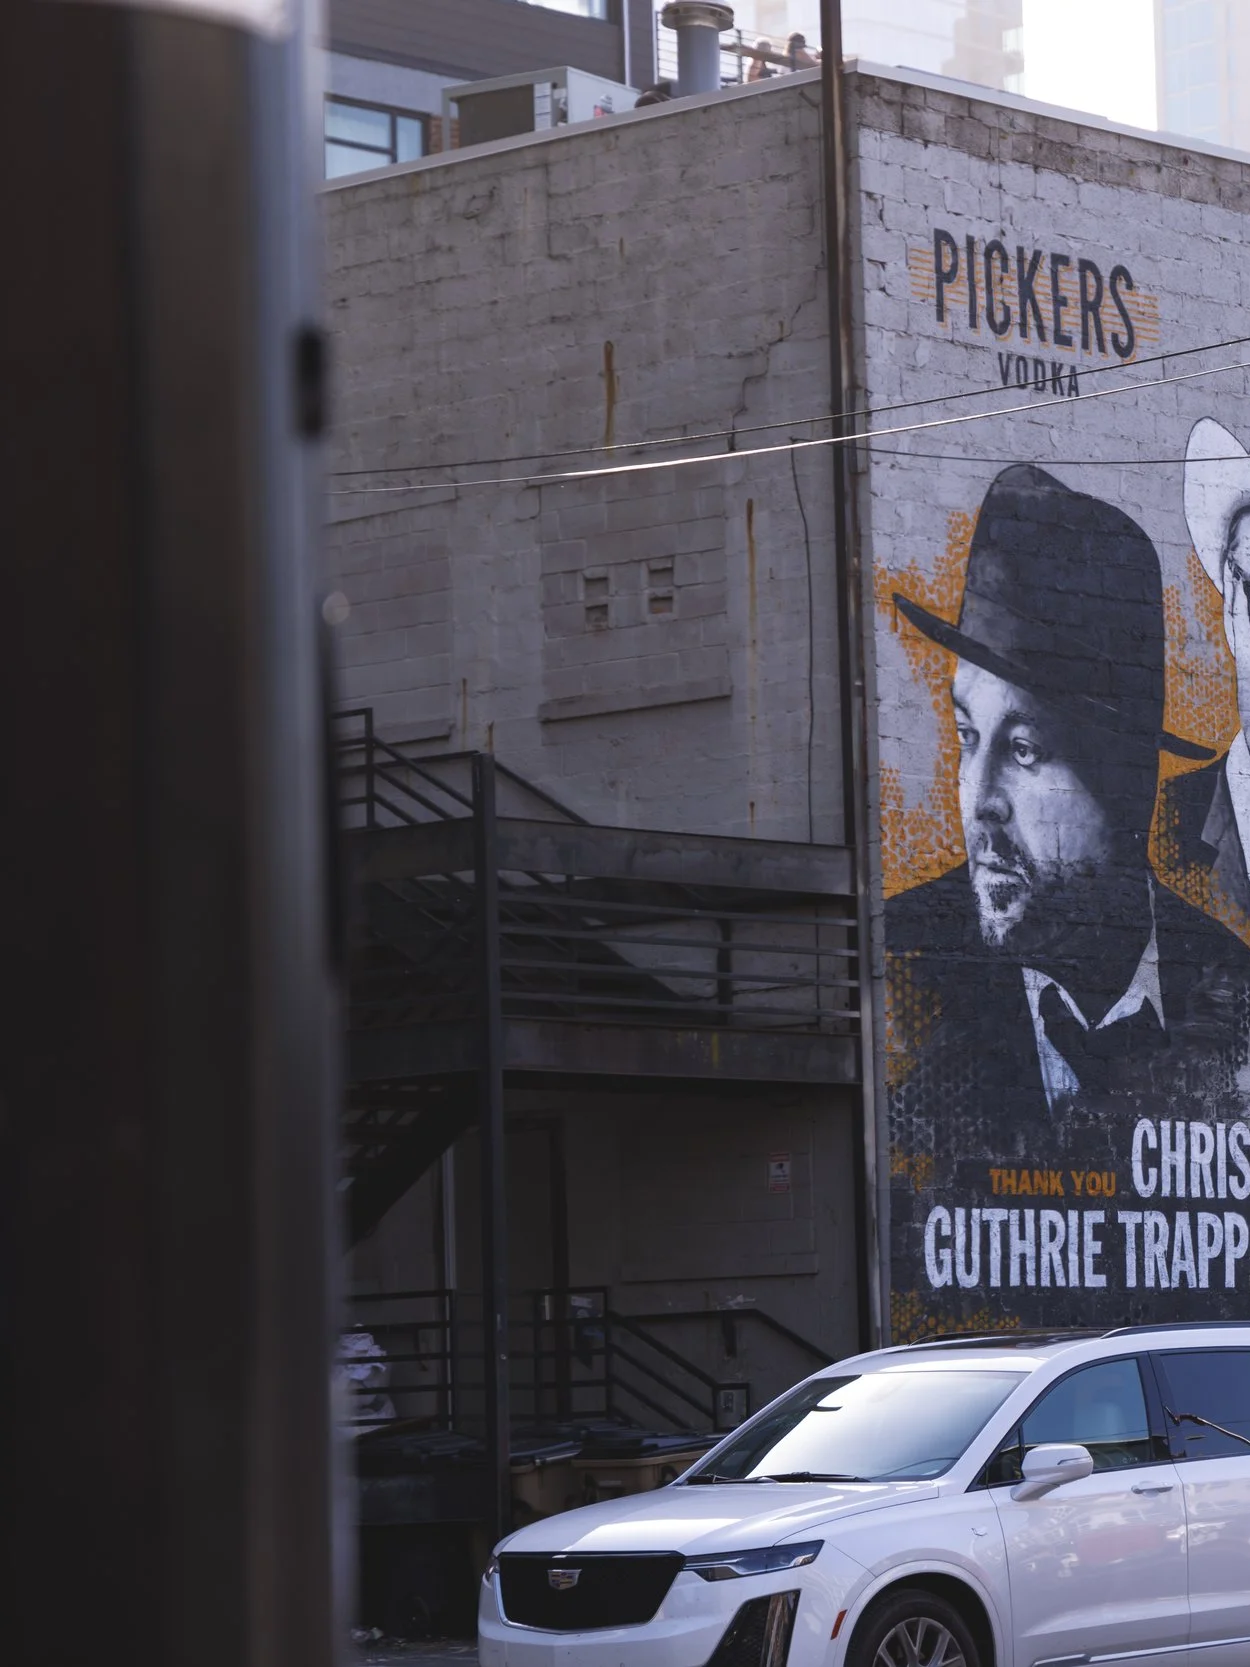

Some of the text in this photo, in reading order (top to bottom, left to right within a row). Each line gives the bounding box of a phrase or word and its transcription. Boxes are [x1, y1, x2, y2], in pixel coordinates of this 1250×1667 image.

[933, 228, 1136, 360] PICKERS
[997, 352, 1080, 398] VODKA
[989, 1168, 1117, 1198] THANK YOU
[924, 1205, 1250, 1289] GUTHRIE TRAPP
